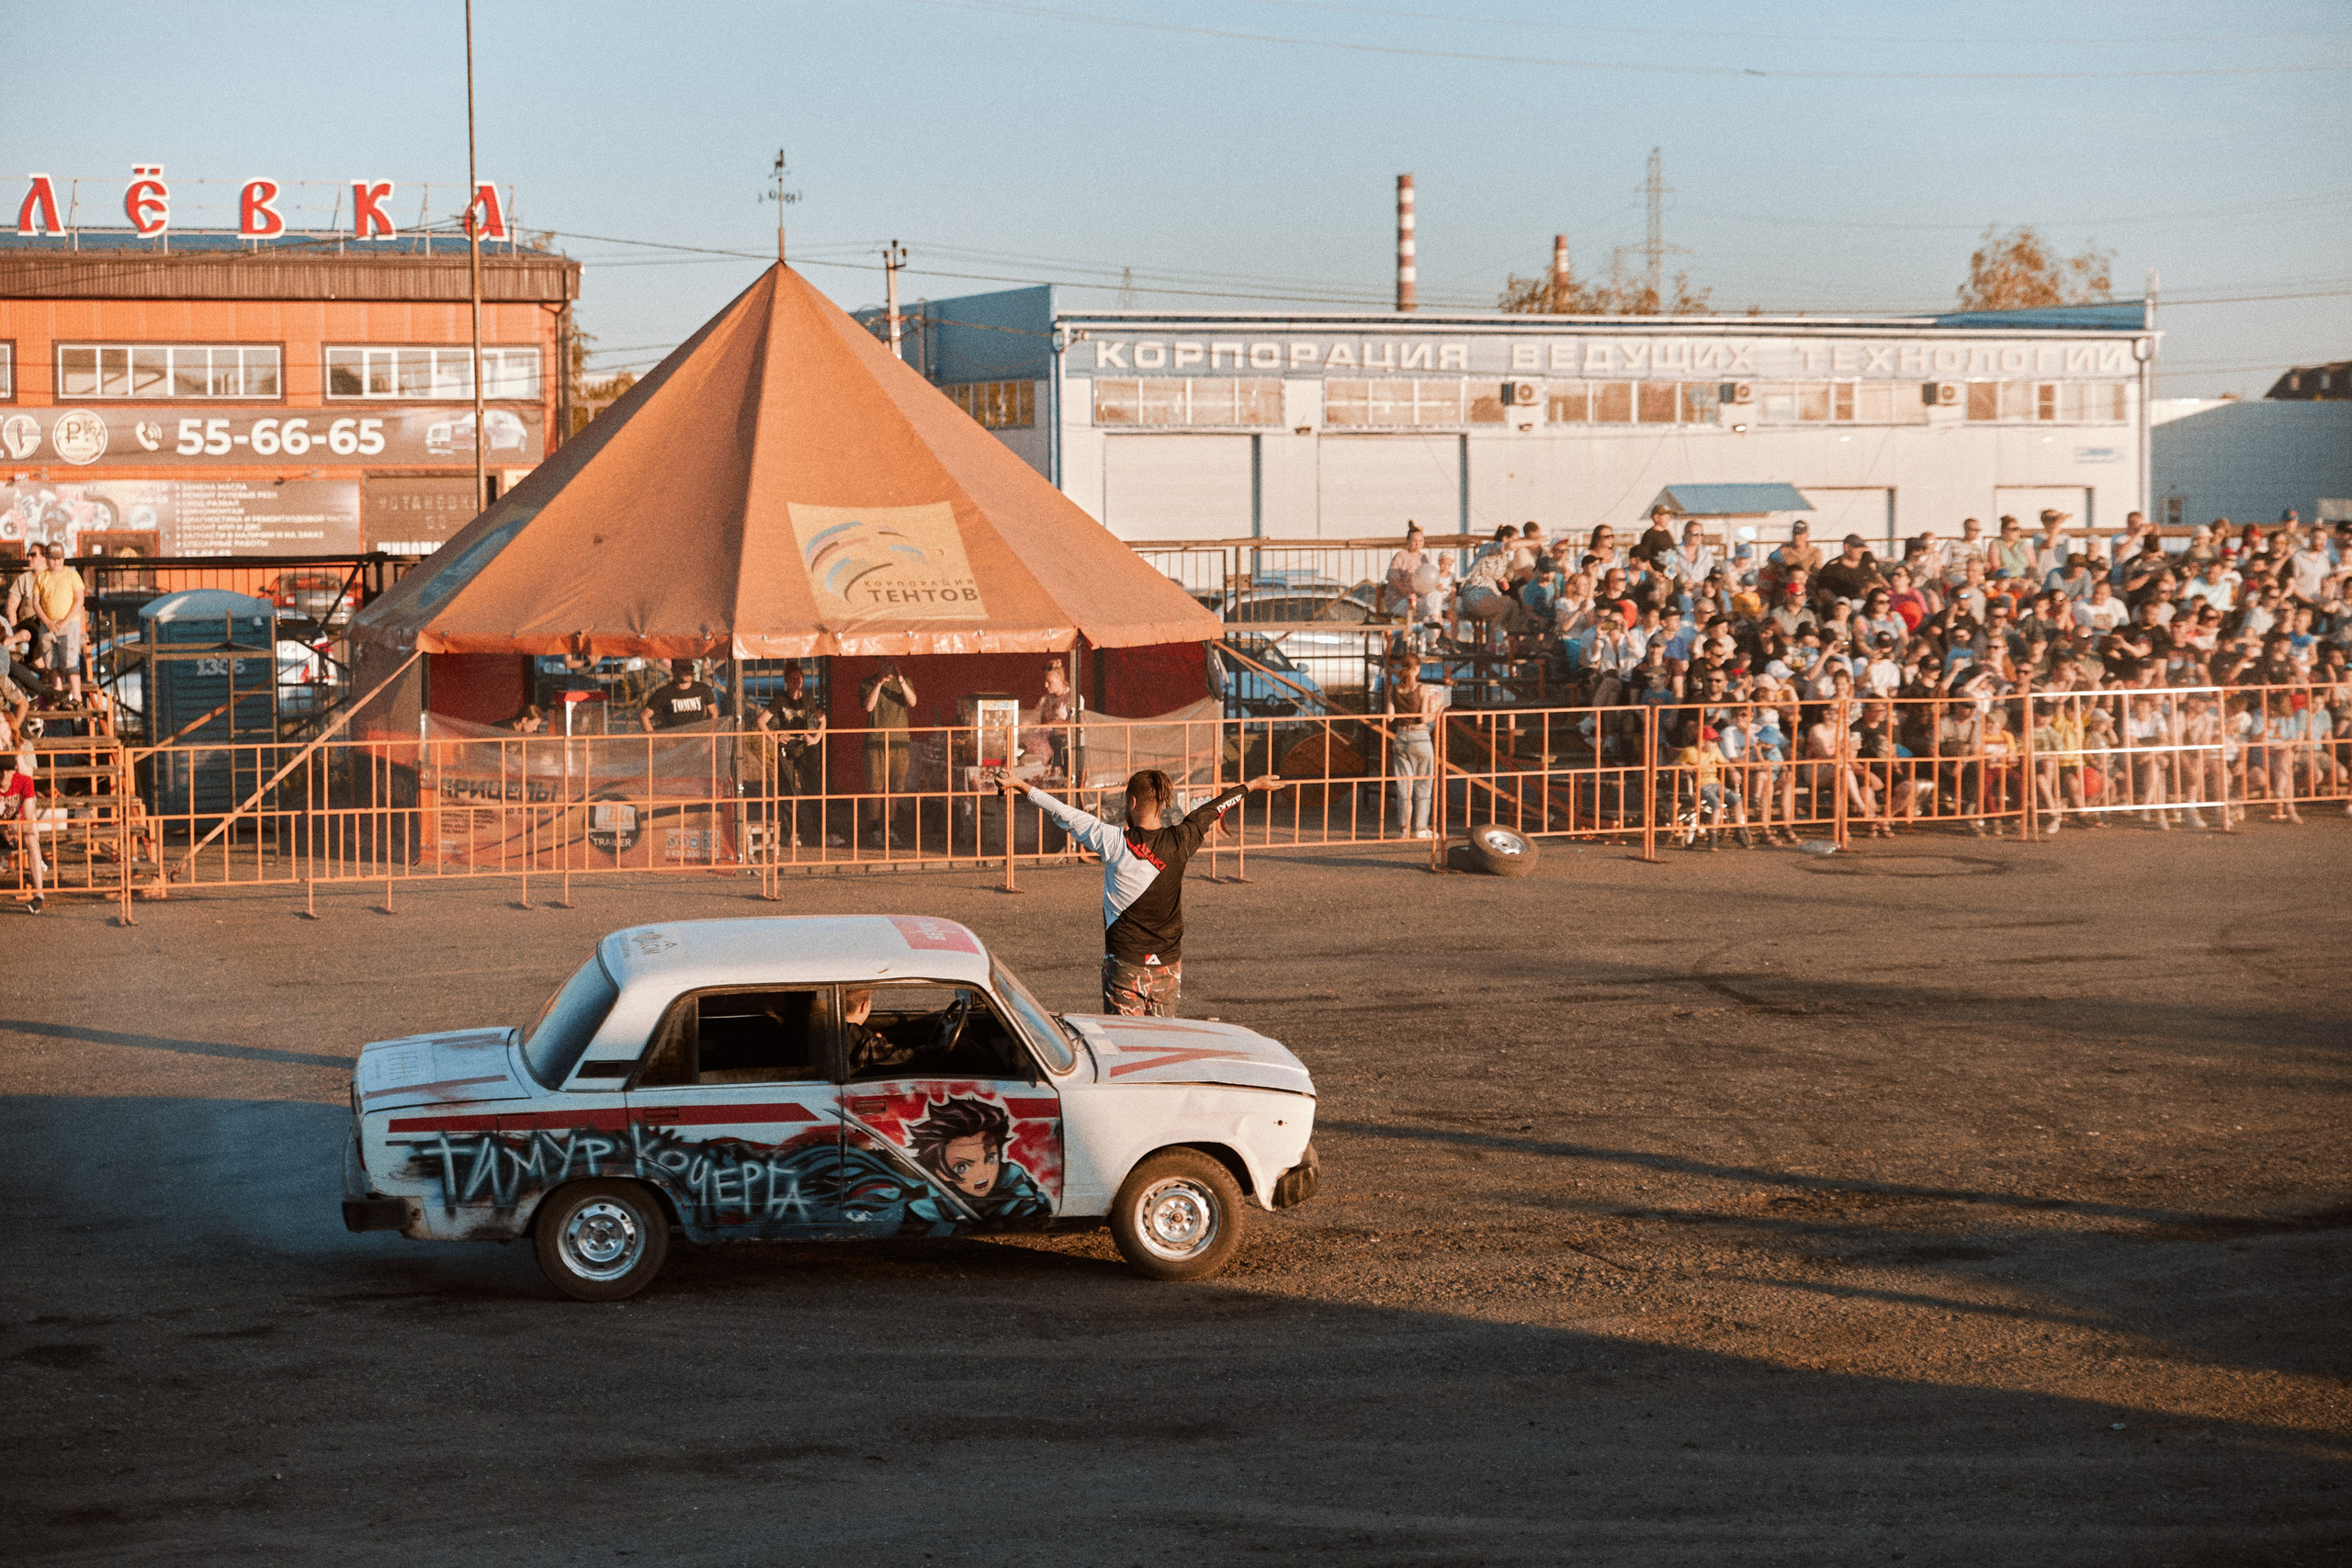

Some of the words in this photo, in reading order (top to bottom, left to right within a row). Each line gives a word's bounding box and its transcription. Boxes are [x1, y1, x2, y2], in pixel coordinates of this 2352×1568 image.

[1095, 340, 1468, 372] КОРПОРАЦИЯ
[1511, 343, 1754, 372] ВЕДУЩИХ
[176, 418, 386, 456] 55-66-65
[864, 578, 974, 587] КОРПОРАЦИЯ
[866, 587, 978, 603] ТЕНТОВ
[671, 695, 702, 714] TOMMY
[1216, 794, 1243, 814] ATAKI
[1136, 842, 1167, 872] ATAKI
